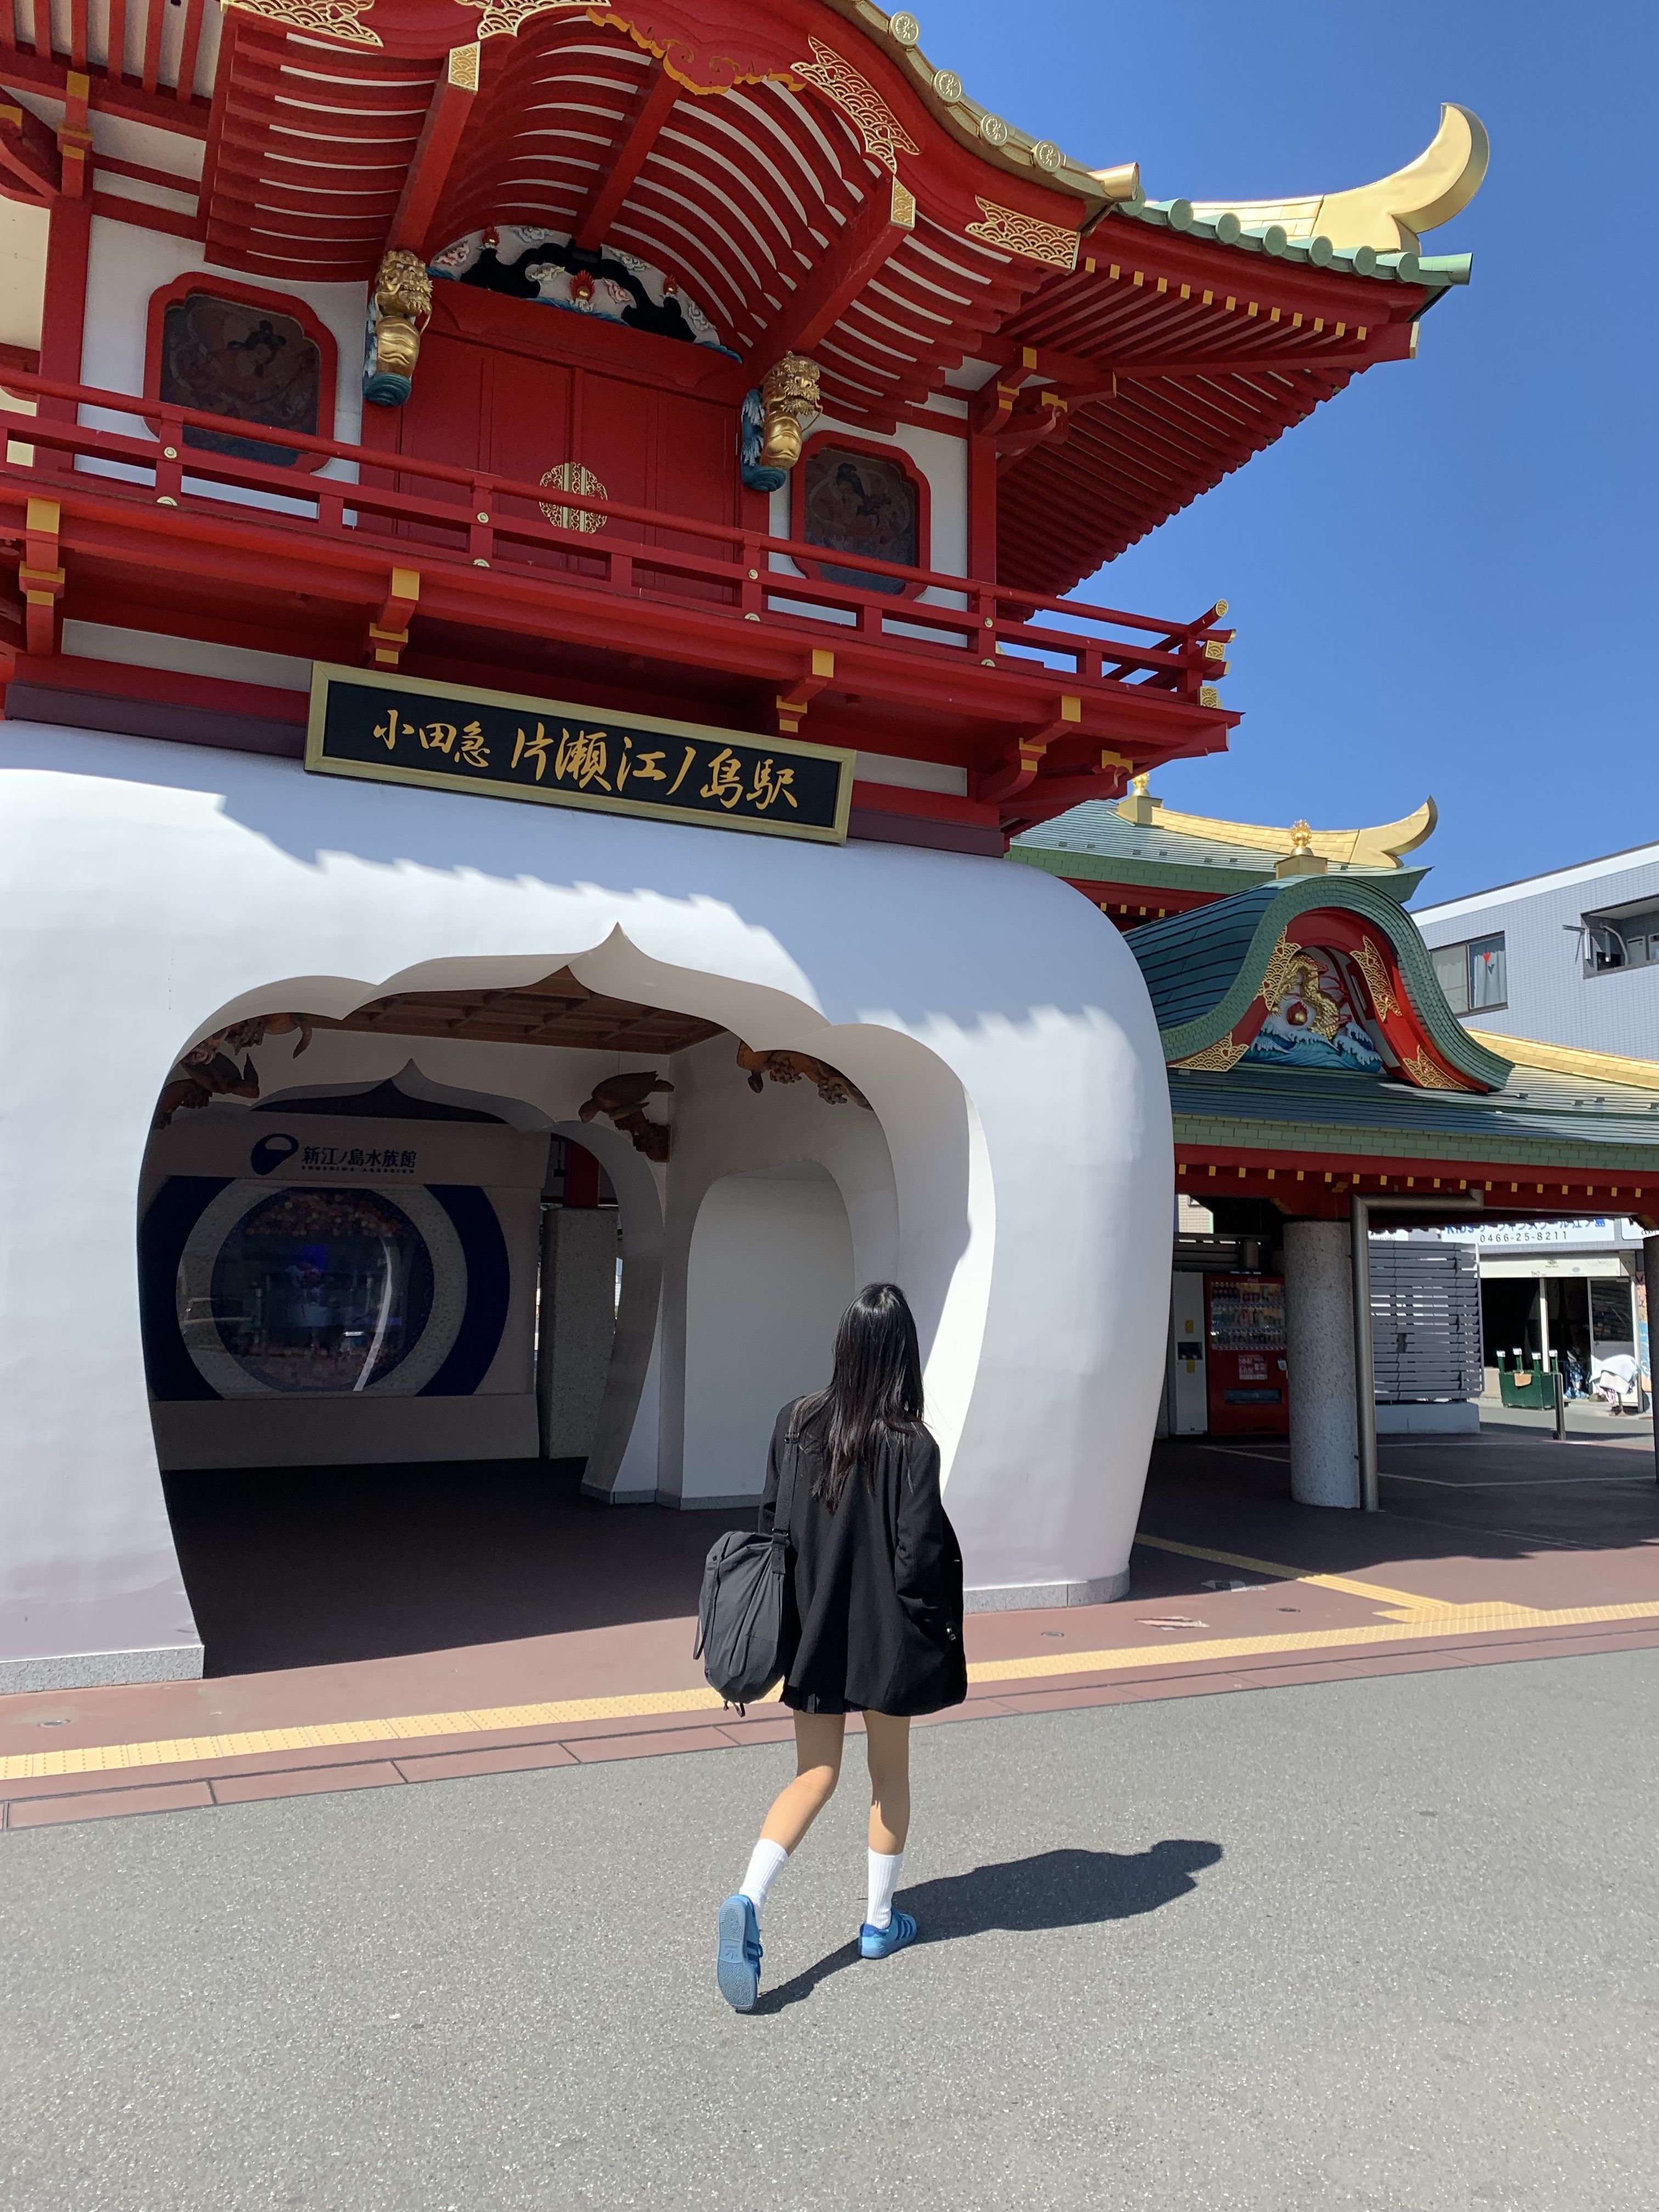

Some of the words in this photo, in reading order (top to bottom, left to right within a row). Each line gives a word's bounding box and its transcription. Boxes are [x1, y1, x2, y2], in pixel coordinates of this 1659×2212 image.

[374, 709, 489, 767] 小田急
[302, 1146, 416, 1168] 新江ノ島水族館
[1480, 1231, 1567, 1243] 0466-25-8211
